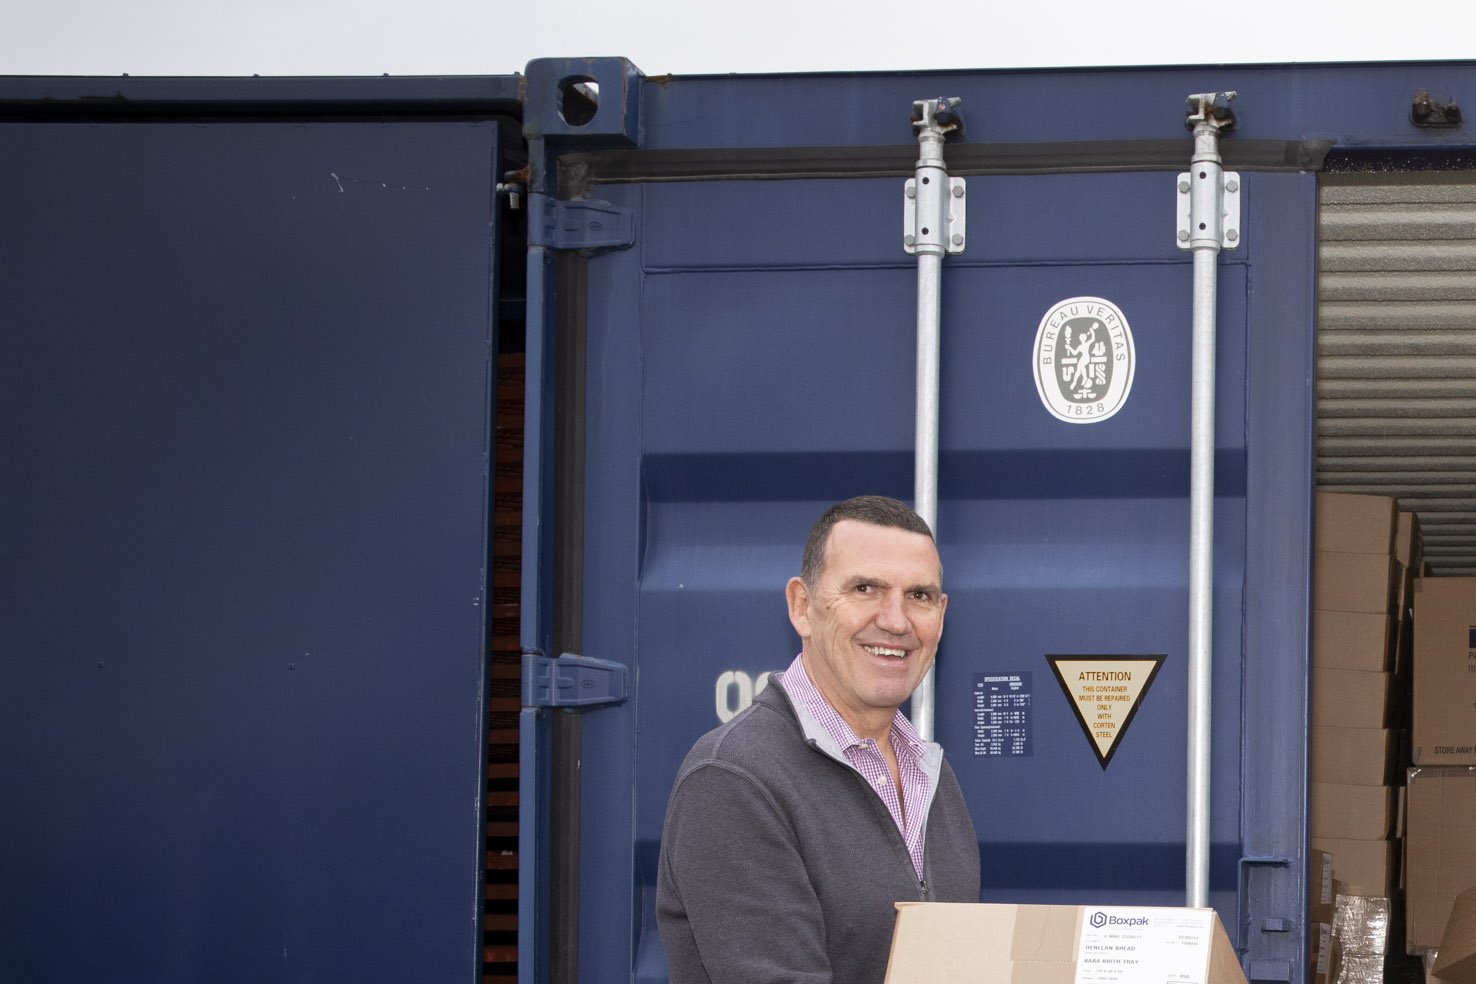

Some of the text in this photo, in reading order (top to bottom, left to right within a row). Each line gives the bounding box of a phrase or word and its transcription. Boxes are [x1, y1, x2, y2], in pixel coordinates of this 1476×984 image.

[1043, 305, 1125, 365] BUREAU VERITAS
[1067, 403, 1104, 415] 1828
[1078, 672, 1132, 681] ATTENTION
[1434, 746, 1454, 754] STORE
[1456, 746, 1473, 754] AWAY
[1108, 915, 1149, 926] Boxpak
